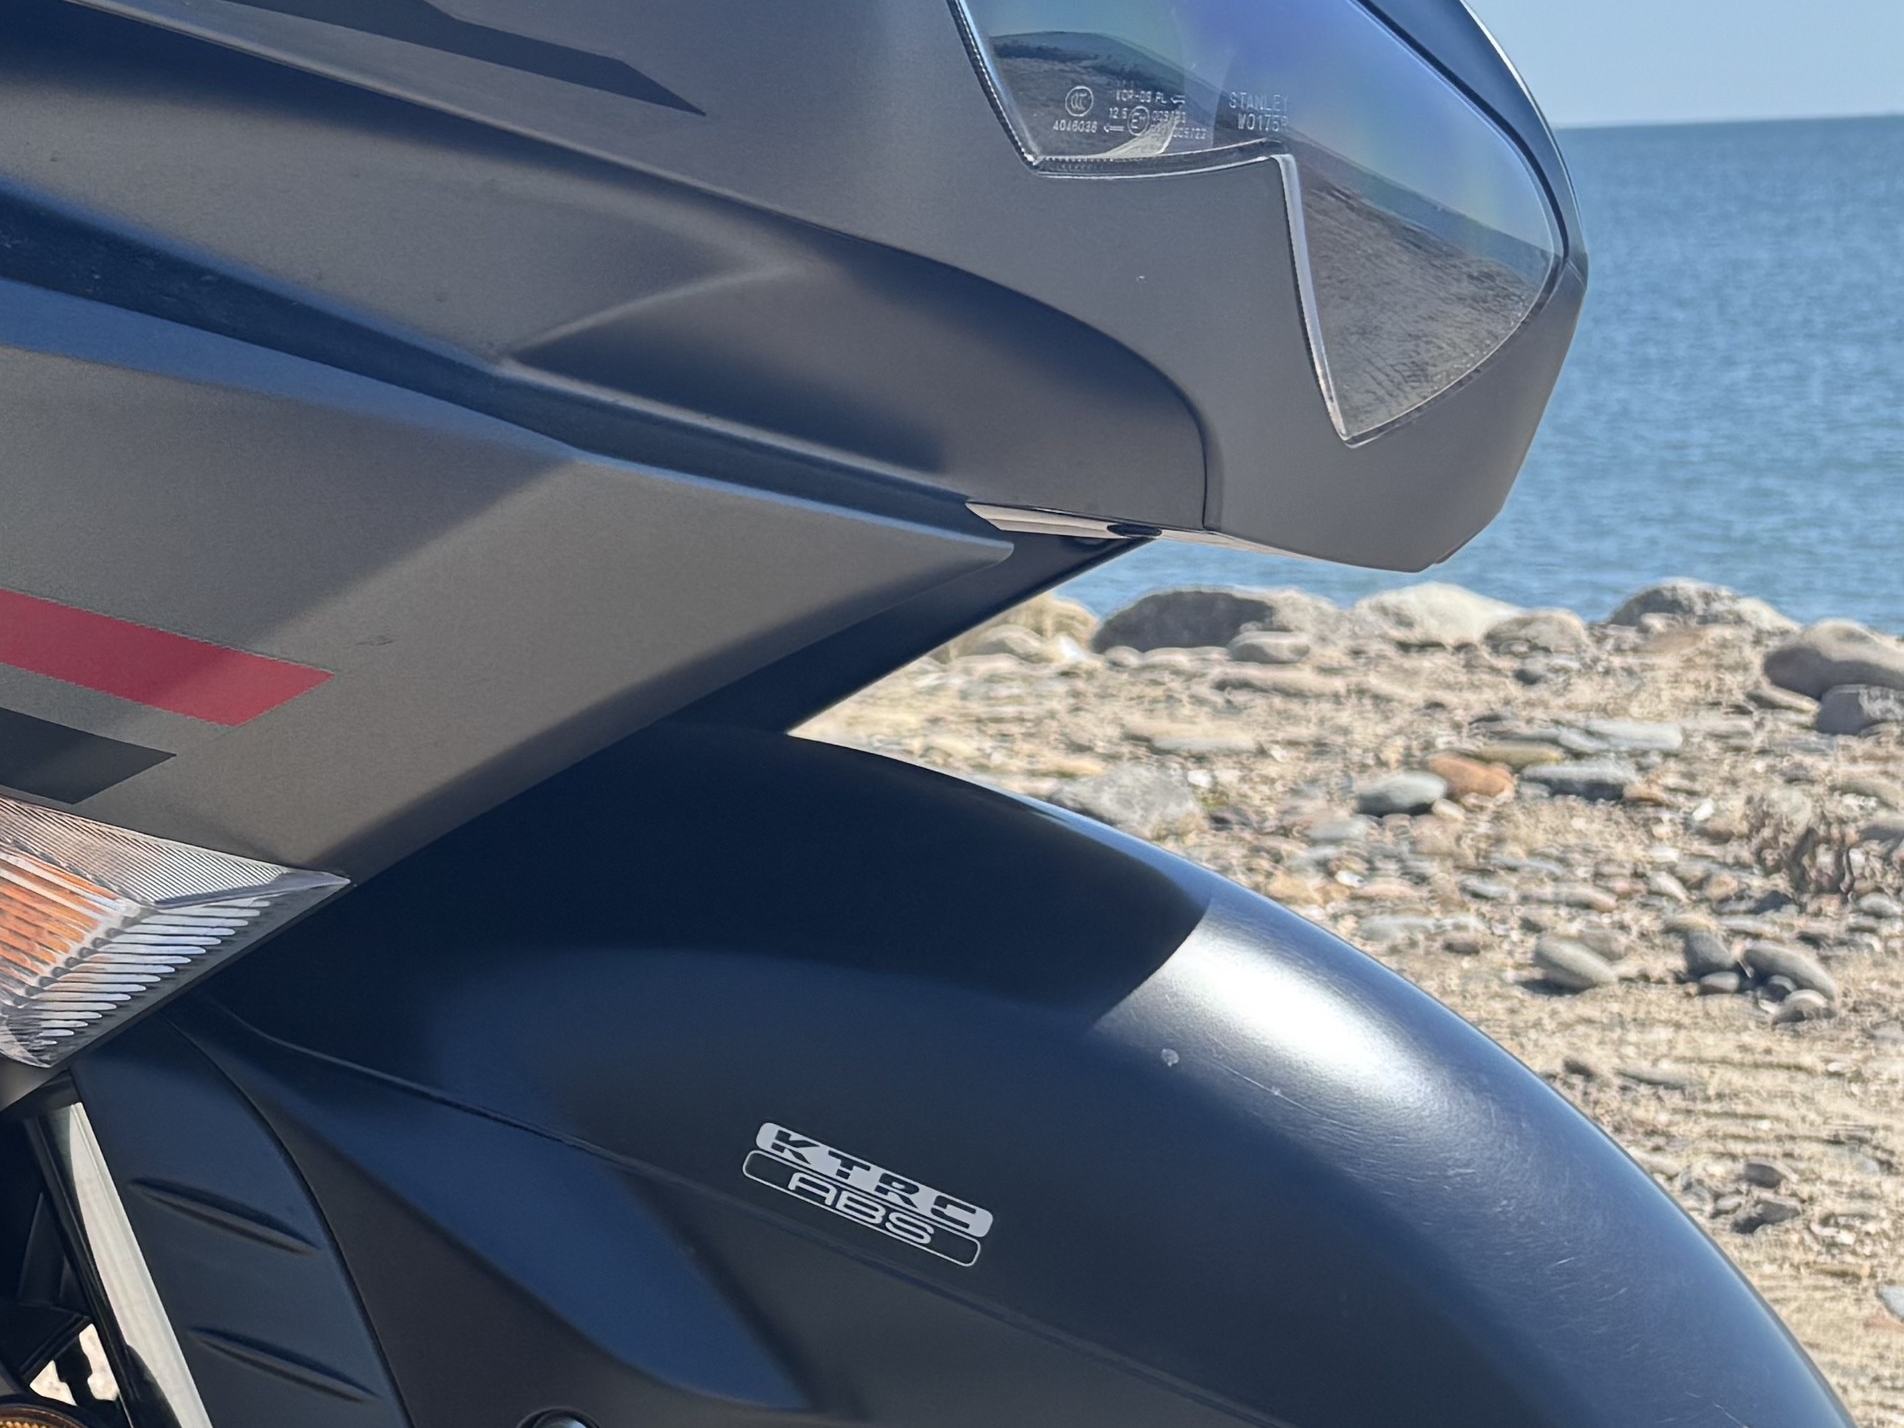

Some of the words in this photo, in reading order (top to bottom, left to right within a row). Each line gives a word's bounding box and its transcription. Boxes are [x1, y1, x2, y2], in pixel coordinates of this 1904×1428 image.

[1229, 91, 1289, 112] STANLEY
[769, 1128, 979, 1230] KTRC
[787, 1171, 935, 1245] ABS
